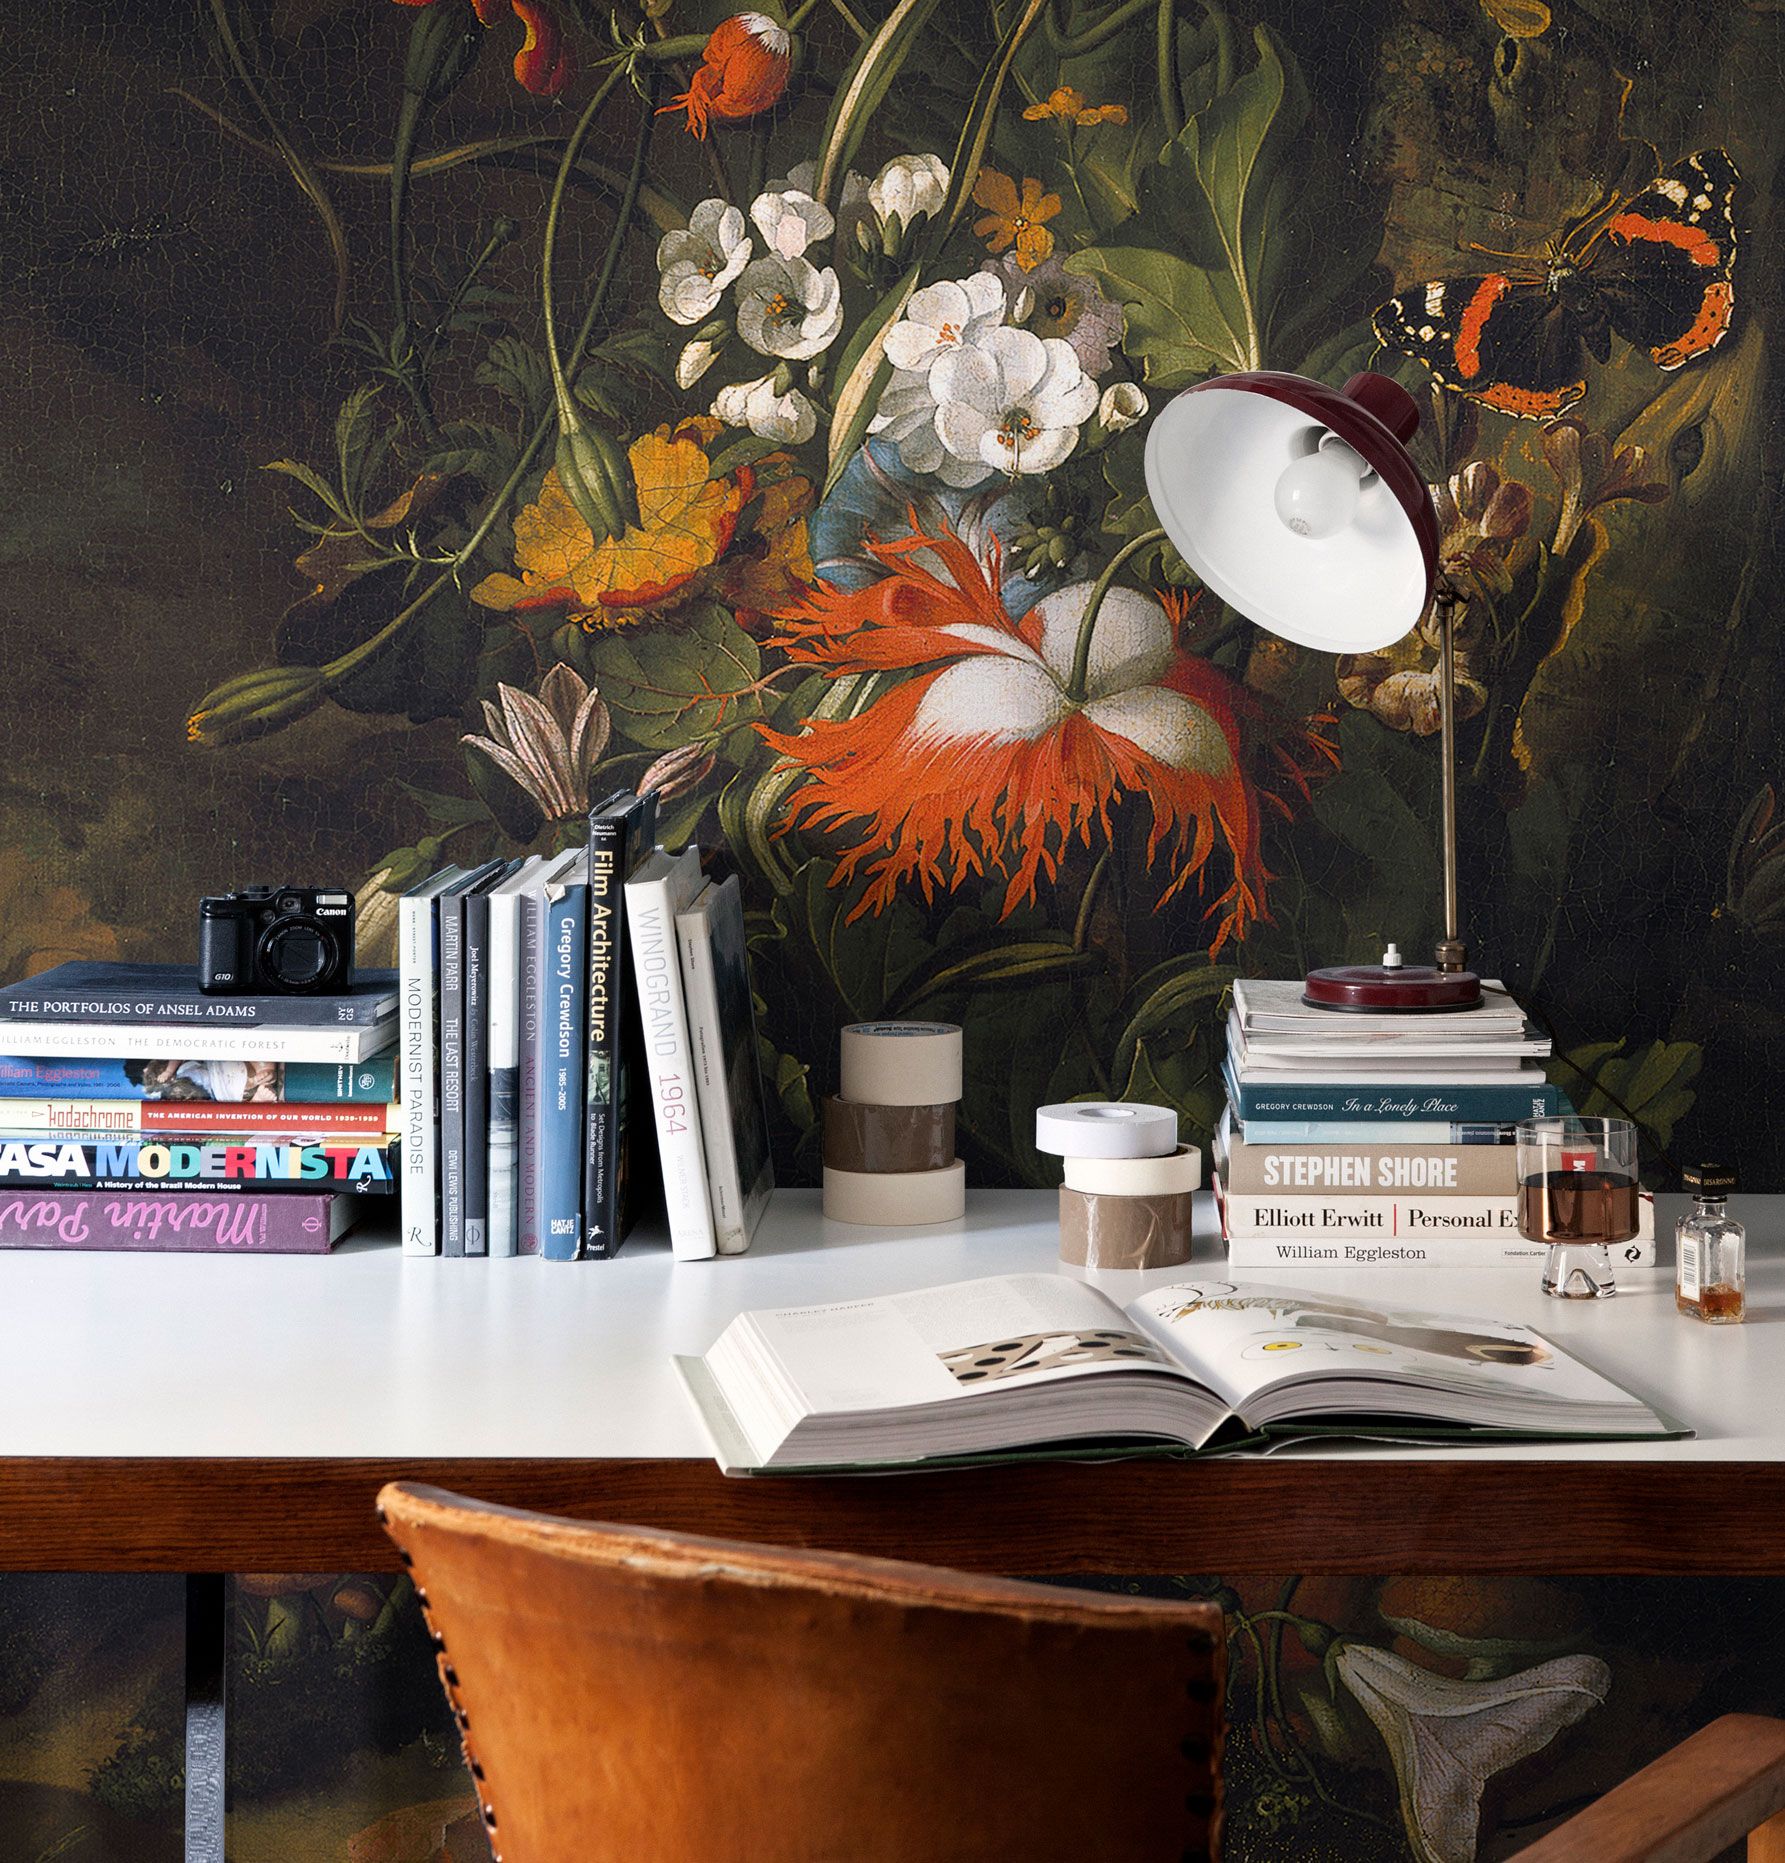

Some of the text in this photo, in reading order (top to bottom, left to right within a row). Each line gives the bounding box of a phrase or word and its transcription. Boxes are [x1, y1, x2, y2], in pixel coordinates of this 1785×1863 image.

[316, 907, 347, 916] Canon
[445, 915, 458, 990] MARTIN PARR
[468, 946, 479, 962] Joel
[590, 850, 614, 1043] Film Architecture
[214, 973, 232, 981] G10
[525, 890, 537, 1041] WILLIAM EGGLESTON
[468, 963, 479, 1006] Meyerowitz
[557, 917, 575, 1058] Gregory Crewdson
[9, 1001, 256, 1017] THE PORTFOLIOS OF ANSEL ADAMS
[338, 1007, 346, 1020] NY
[346, 1008, 354, 1021] GS
[637, 907, 688, 1136] WINOGRAND 1964
[1, 1035, 286, 1050] ILLIAM EGGLESTON THE DEMOCRATIC FOREST
[0, 1064, 100, 1083] illiam Eggleston
[445, 1018, 459, 1113] THE LAST RESORT
[469, 1039, 479, 1083] Westerbeck
[408, 978, 424, 1175] MODERNIST PARADISE
[590, 1112, 596, 1121] to
[1292, 1103, 1334, 1111] CREWDSON
[1341, 1097, 1458, 1117] In a Lonely Place
[524, 1056, 537, 1225] ANCIENT AND MODERN
[597, 1125, 605, 1150] Designs
[0, 1144, 387, 1180] ASA MODERNISTA
[1264, 1155, 1458, 1187] STEPHEN SHORE
[104, 1181, 133, 1190] History
[134, 1181, 144, 1189] of
[145, 1181, 159, 1189] the
[184, 1182, 215, 1190] Modern
[217, 1182, 242, 1190] House
[448, 1150, 458, 1241] DEWI LEWIS PUBLISHING
[595, 1168, 604, 1204] Metropolis
[104, 1203, 258, 1245] Martin
[1253, 1208, 1315, 1227] Elliott
[1321, 1208, 1383, 1227] Erwitt
[1408, 1209, 1492, 1228] Personal
[586, 1243, 605, 1251] Prestel
[1276, 1246, 1427, 1262] William Eggleston
